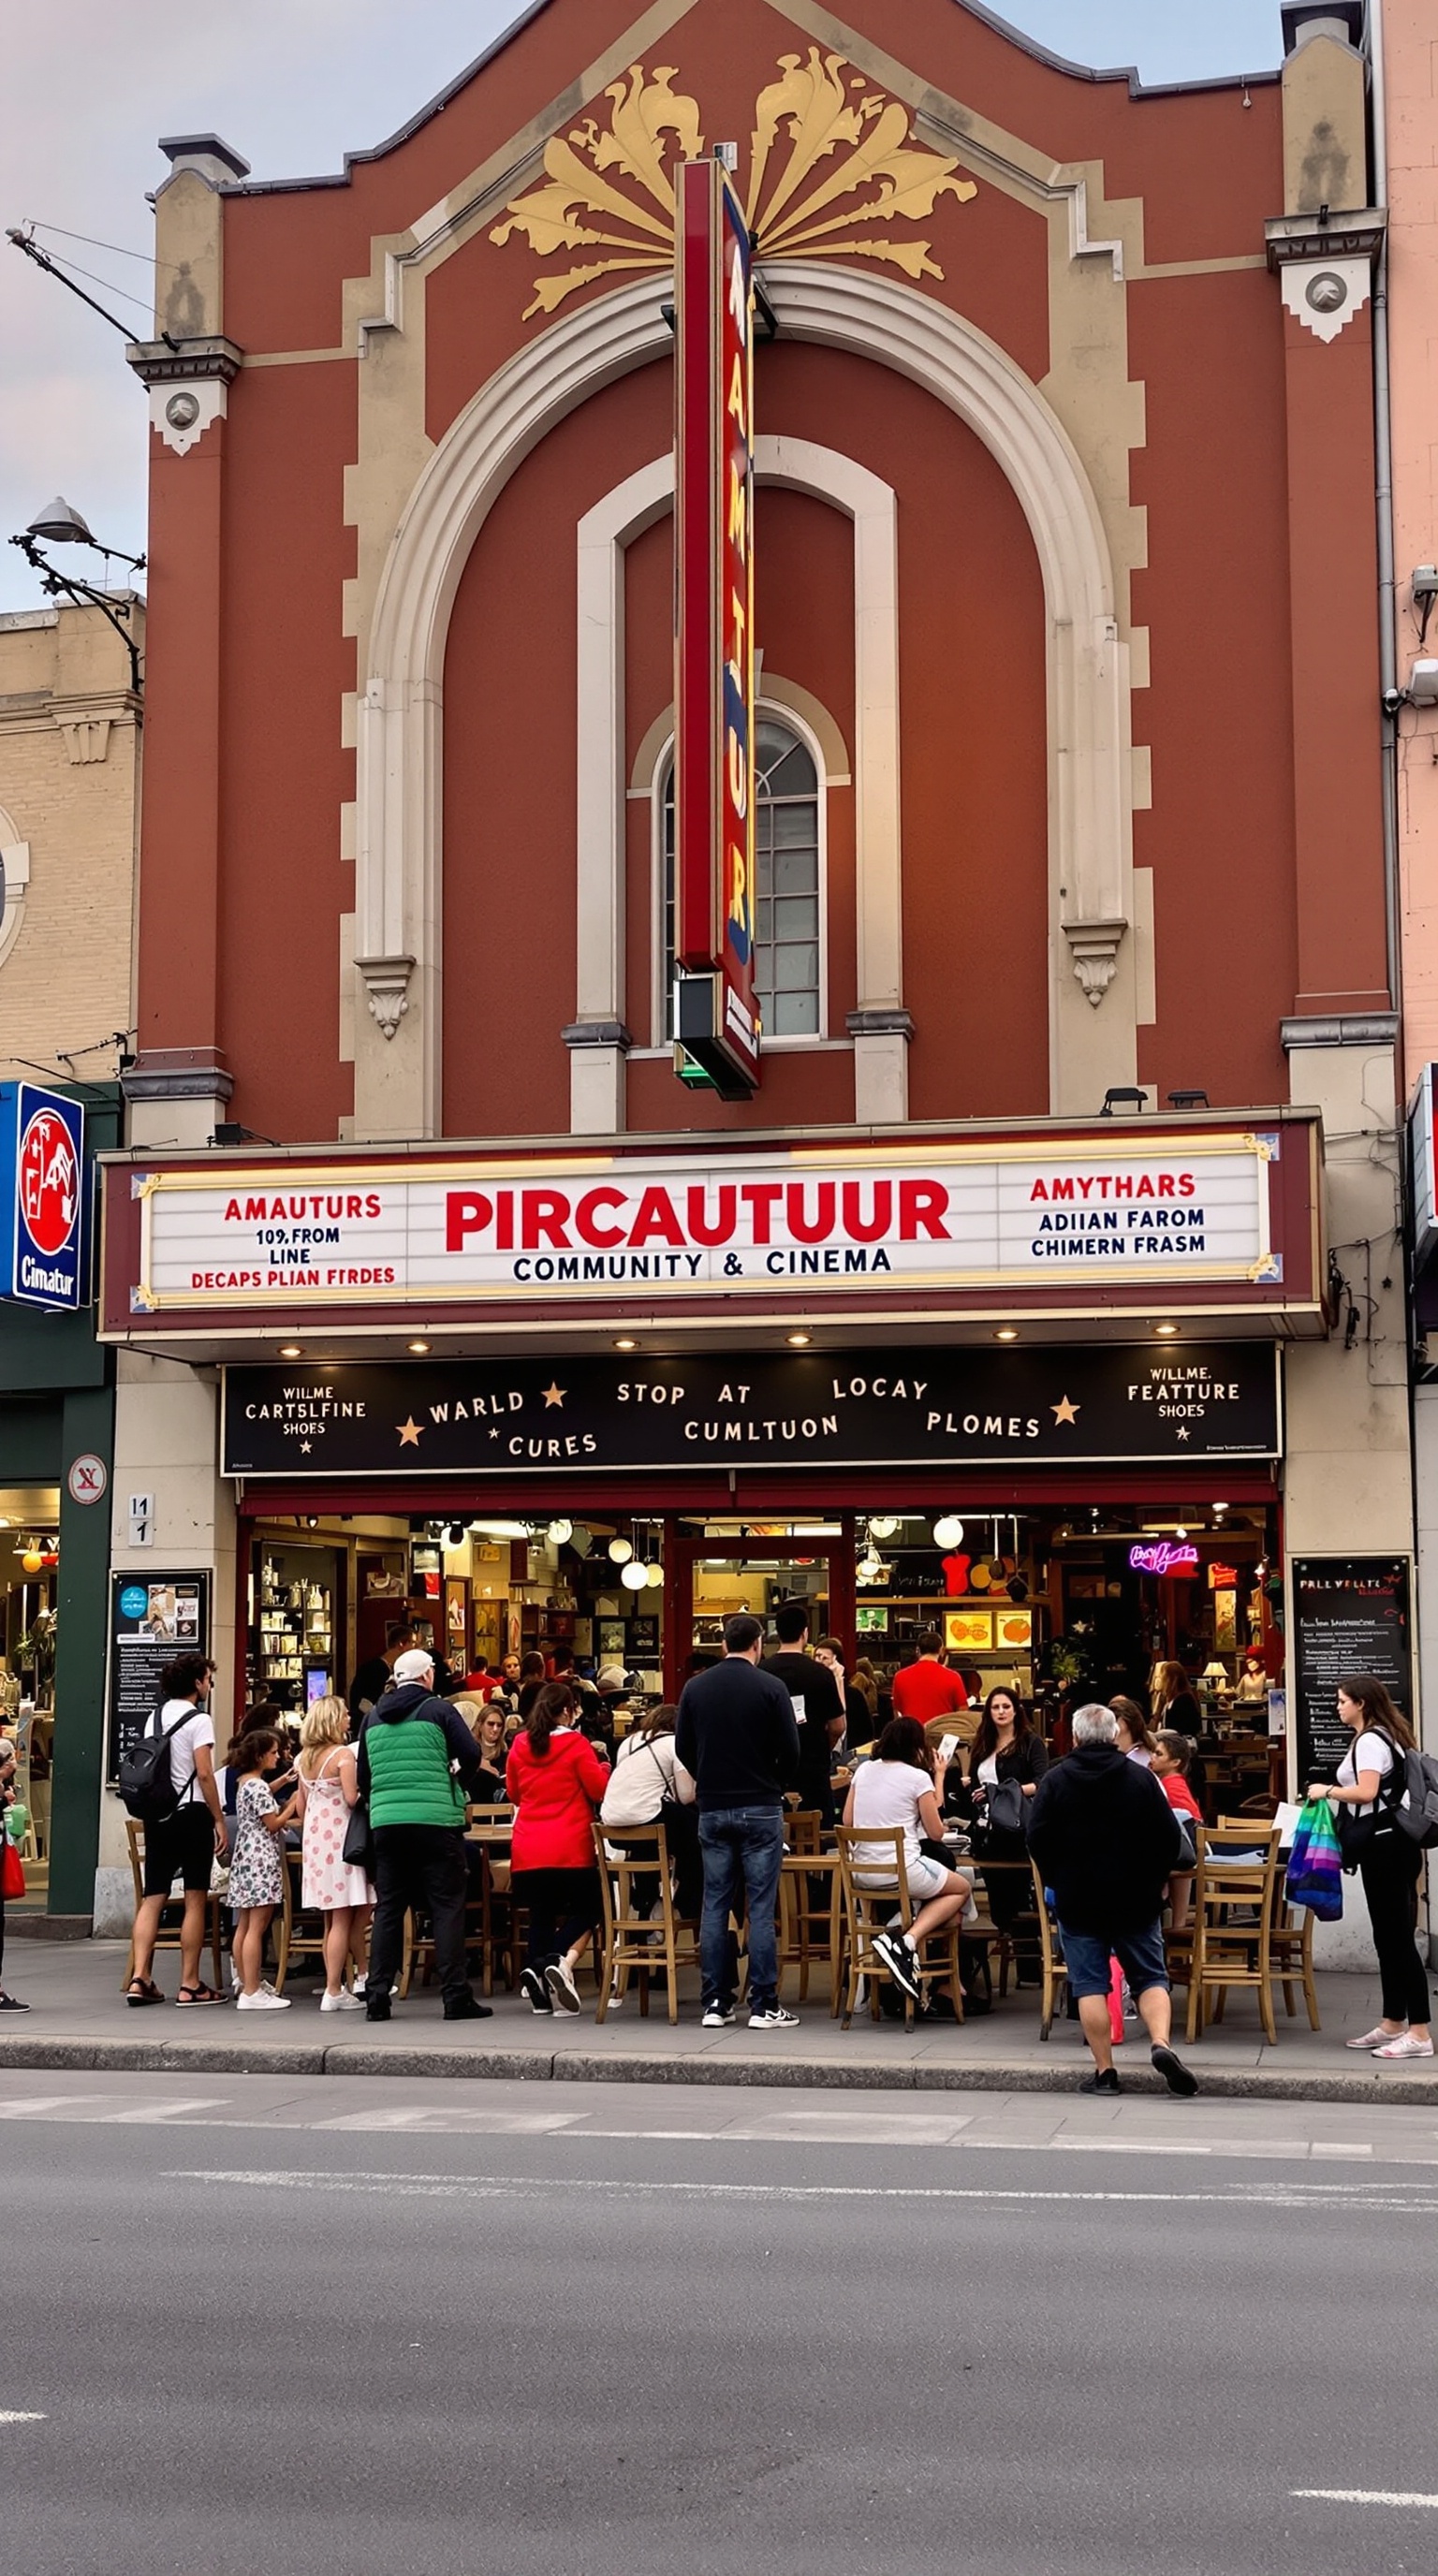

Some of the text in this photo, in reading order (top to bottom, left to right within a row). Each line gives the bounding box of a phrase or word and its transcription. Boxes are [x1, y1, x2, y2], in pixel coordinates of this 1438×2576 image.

[1030, 1172, 1196, 1202] AMYTHARS
[224, 1193, 382, 1222] AMAUTURS
[447, 1178, 951, 1251] PIRCAUTUUR
[1127, 1208, 1204, 1228] FAROM
[270, 1248, 311, 1265] LINE
[1031, 1235, 1205, 1257] CHIMERN FRASM
[513, 1248, 891, 1281] COMMUNITY & CINEMA
[191, 1270, 262, 1290] DECAPS
[267, 1270, 320, 1287] PLIAN
[617, 1383, 751, 1405] STOP AT
[832, 1377, 928, 1400] LOCAY
[1128, 1383, 1240, 1400] FEATTURE
[429, 1392, 523, 1424] WARLD
[1158, 1404, 1205, 1418] SHOES
[283, 1422, 326, 1435] SHOES
[684, 1412, 1039, 1441] CUMLTUON PLOMES
[508, 1434, 596, 1457] CURES
